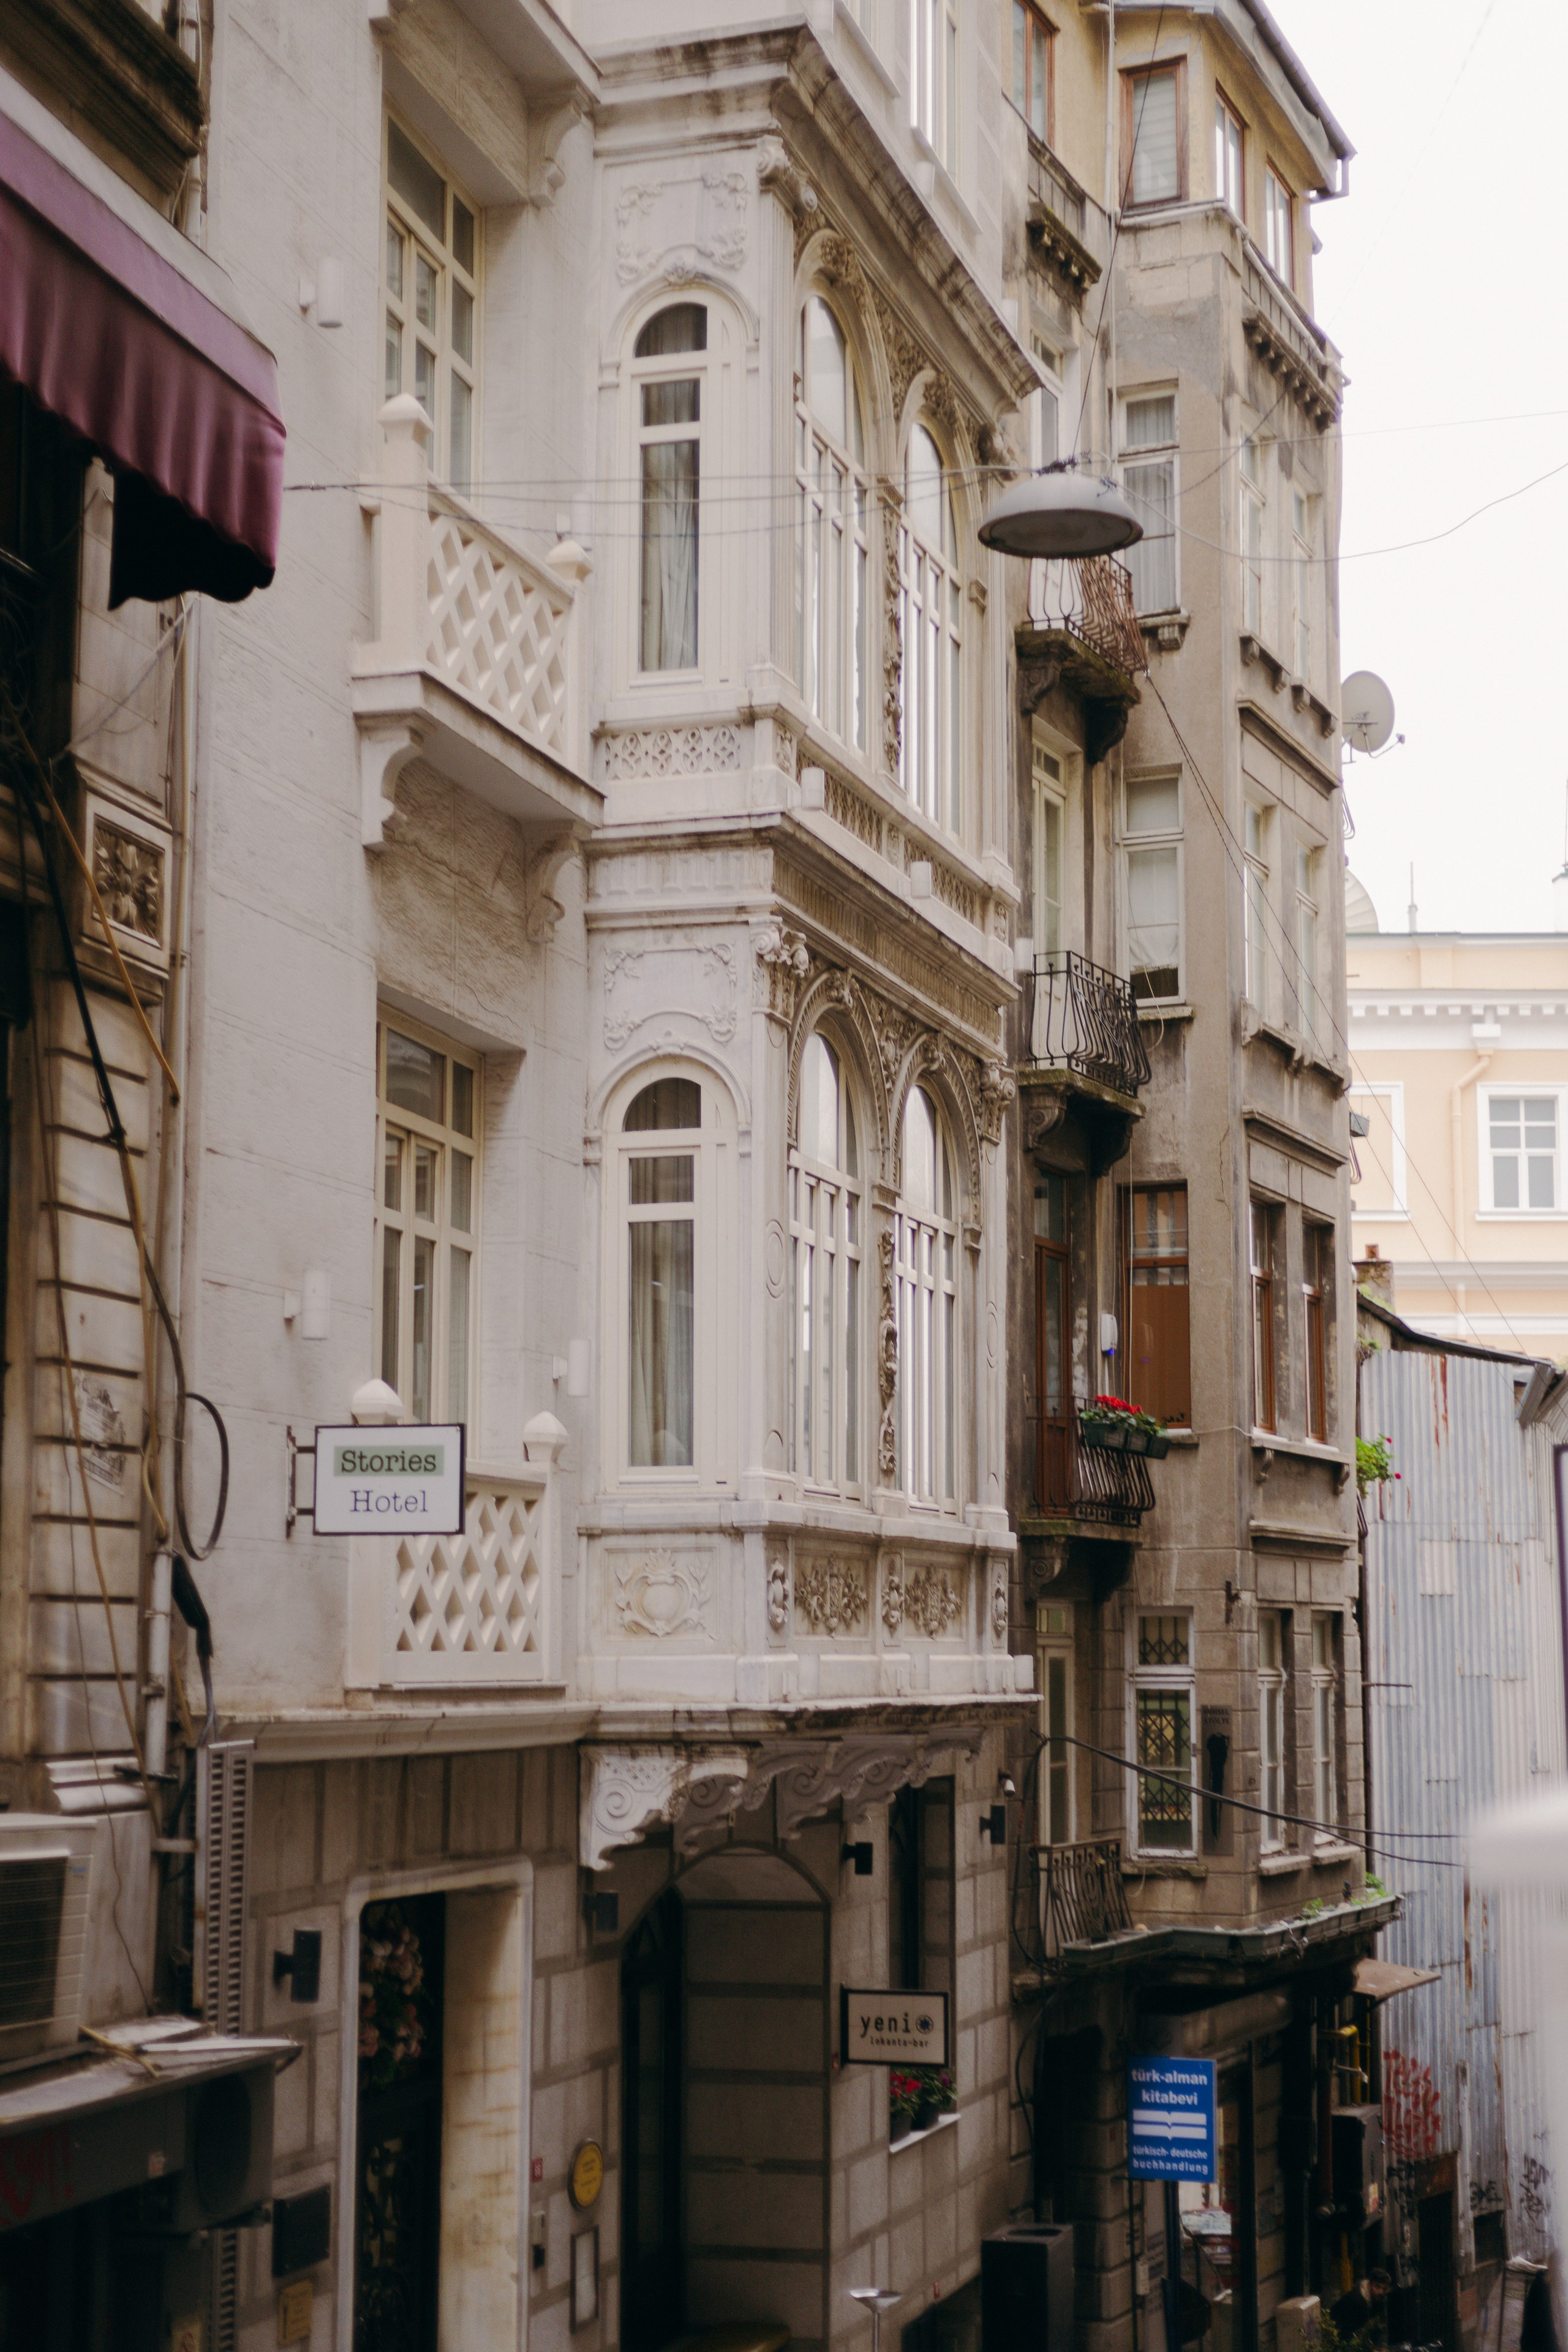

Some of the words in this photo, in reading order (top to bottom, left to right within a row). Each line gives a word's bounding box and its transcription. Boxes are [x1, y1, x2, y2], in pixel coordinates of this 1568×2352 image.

[341, 1449, 437, 1473] Stories
[349, 1490, 429, 1513] Hotel
[859, 2011, 911, 2038] yeni
[1131, 2068, 1208, 2086] türk-alman
[1141, 2089, 1198, 2106] kitabevi
[1170, 2146, 1208, 2160] deutsche
[1133, 2158, 1208, 2175] buchhandlung
